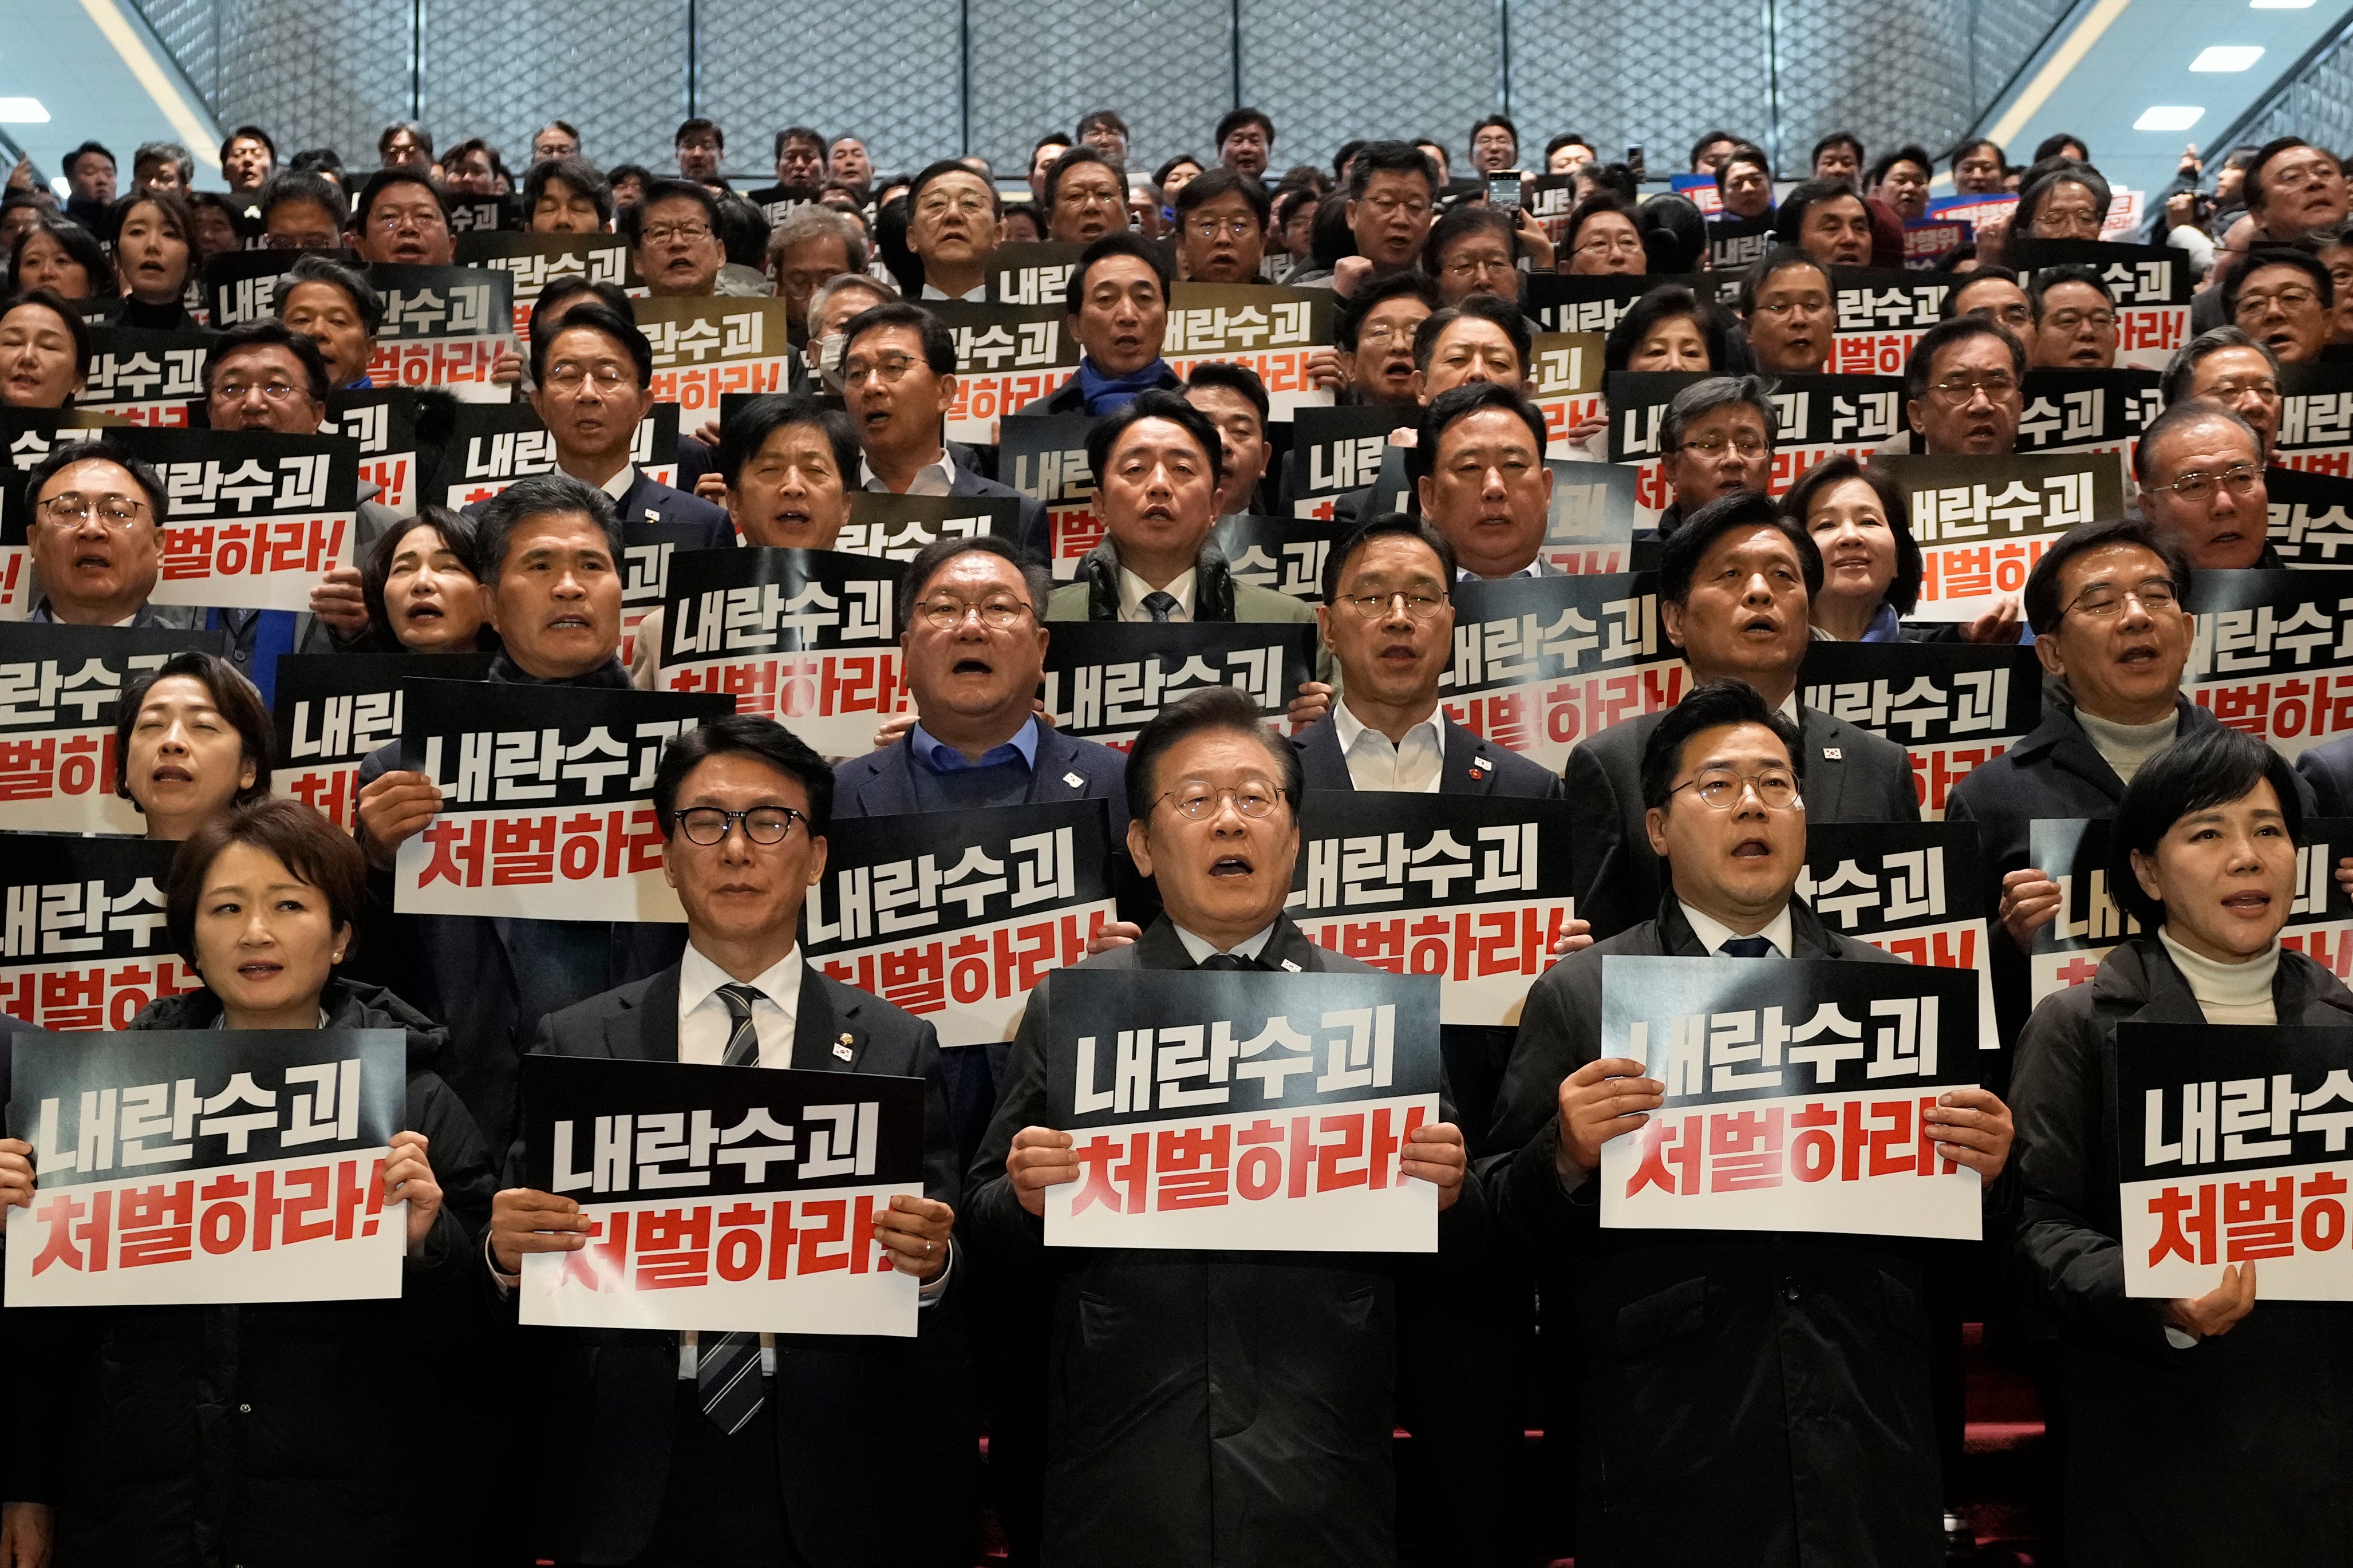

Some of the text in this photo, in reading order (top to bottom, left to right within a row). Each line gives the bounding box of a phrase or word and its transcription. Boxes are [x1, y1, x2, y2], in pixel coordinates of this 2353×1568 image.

[452, 202, 498, 231] 수괴
[1715, 234, 1763, 265] 내란
[1000, 264, 1075, 305] 내란
[1837, 285, 1949, 329] 란수괴
[368, 340, 506, 389] 벌하라!
[638, 312, 764, 365] 란수괴
[86, 348, 207, 398] 란수괴
[650, 362, 781, 410] 벌하라!
[2019, 388, 2105, 445] 수괴
[153, 454, 331, 514] 란수괴
[1310, 435, 1387, 490] 내란
[161, 519, 347, 581] 벌하라!
[2267, 503, 2353, 558] 란수
[1229, 540, 1330, 597] 수괴
[672, 580, 893, 655] 내란수괴
[0, 654, 173, 725] 란수
[290, 689, 403, 759] 내란
[418, 808, 664, 889] 처벌하라
[0, 876, 168, 957] 내란수
[806, 826, 1075, 946] 내란수괴
[1796, 846, 1947, 929] 수괴
[1073, 1004, 1396, 1115] 내란수괴
[1629, 996, 1939, 1098] 내란수괴
[36, 1058, 361, 1176] 내란수괴
[552, 1101, 879, 1194] 내란수괴
[1625, 1096, 1959, 1200] 처벌하라
[31, 1158, 386, 1278] 처벌하라!
